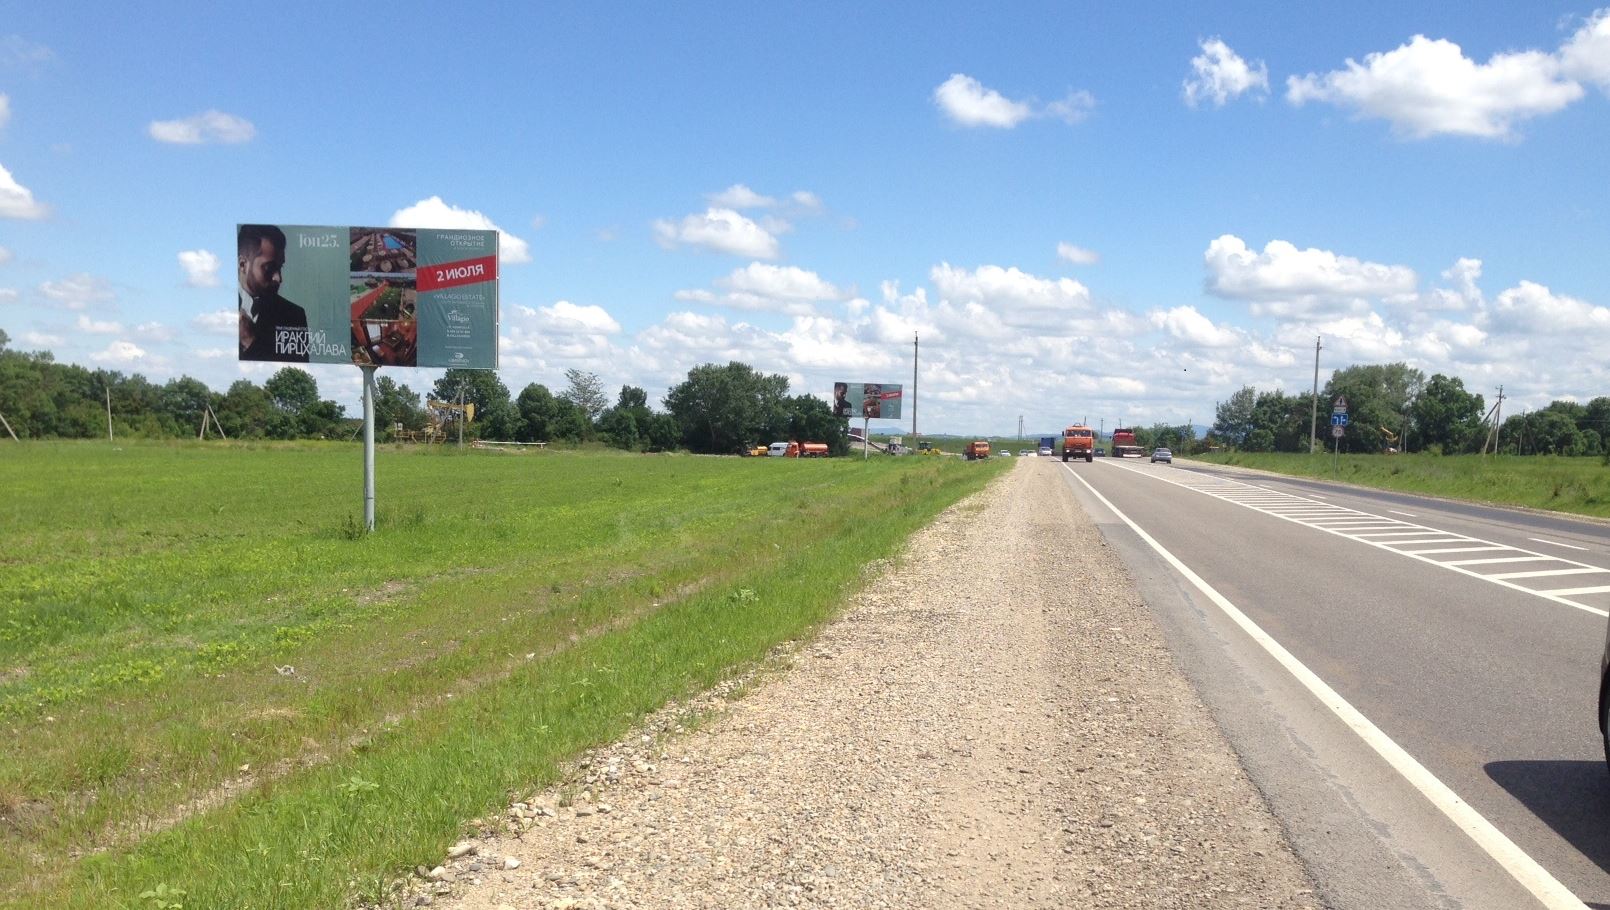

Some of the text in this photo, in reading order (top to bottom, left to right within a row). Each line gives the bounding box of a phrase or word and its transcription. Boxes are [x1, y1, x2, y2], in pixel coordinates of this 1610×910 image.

[436, 264, 484, 282] 2 ИЮЛЯ
[275, 330, 326, 344] ИРАКЛИЙ
[275, 342, 347, 357] ПИРЦХАЛАВА
